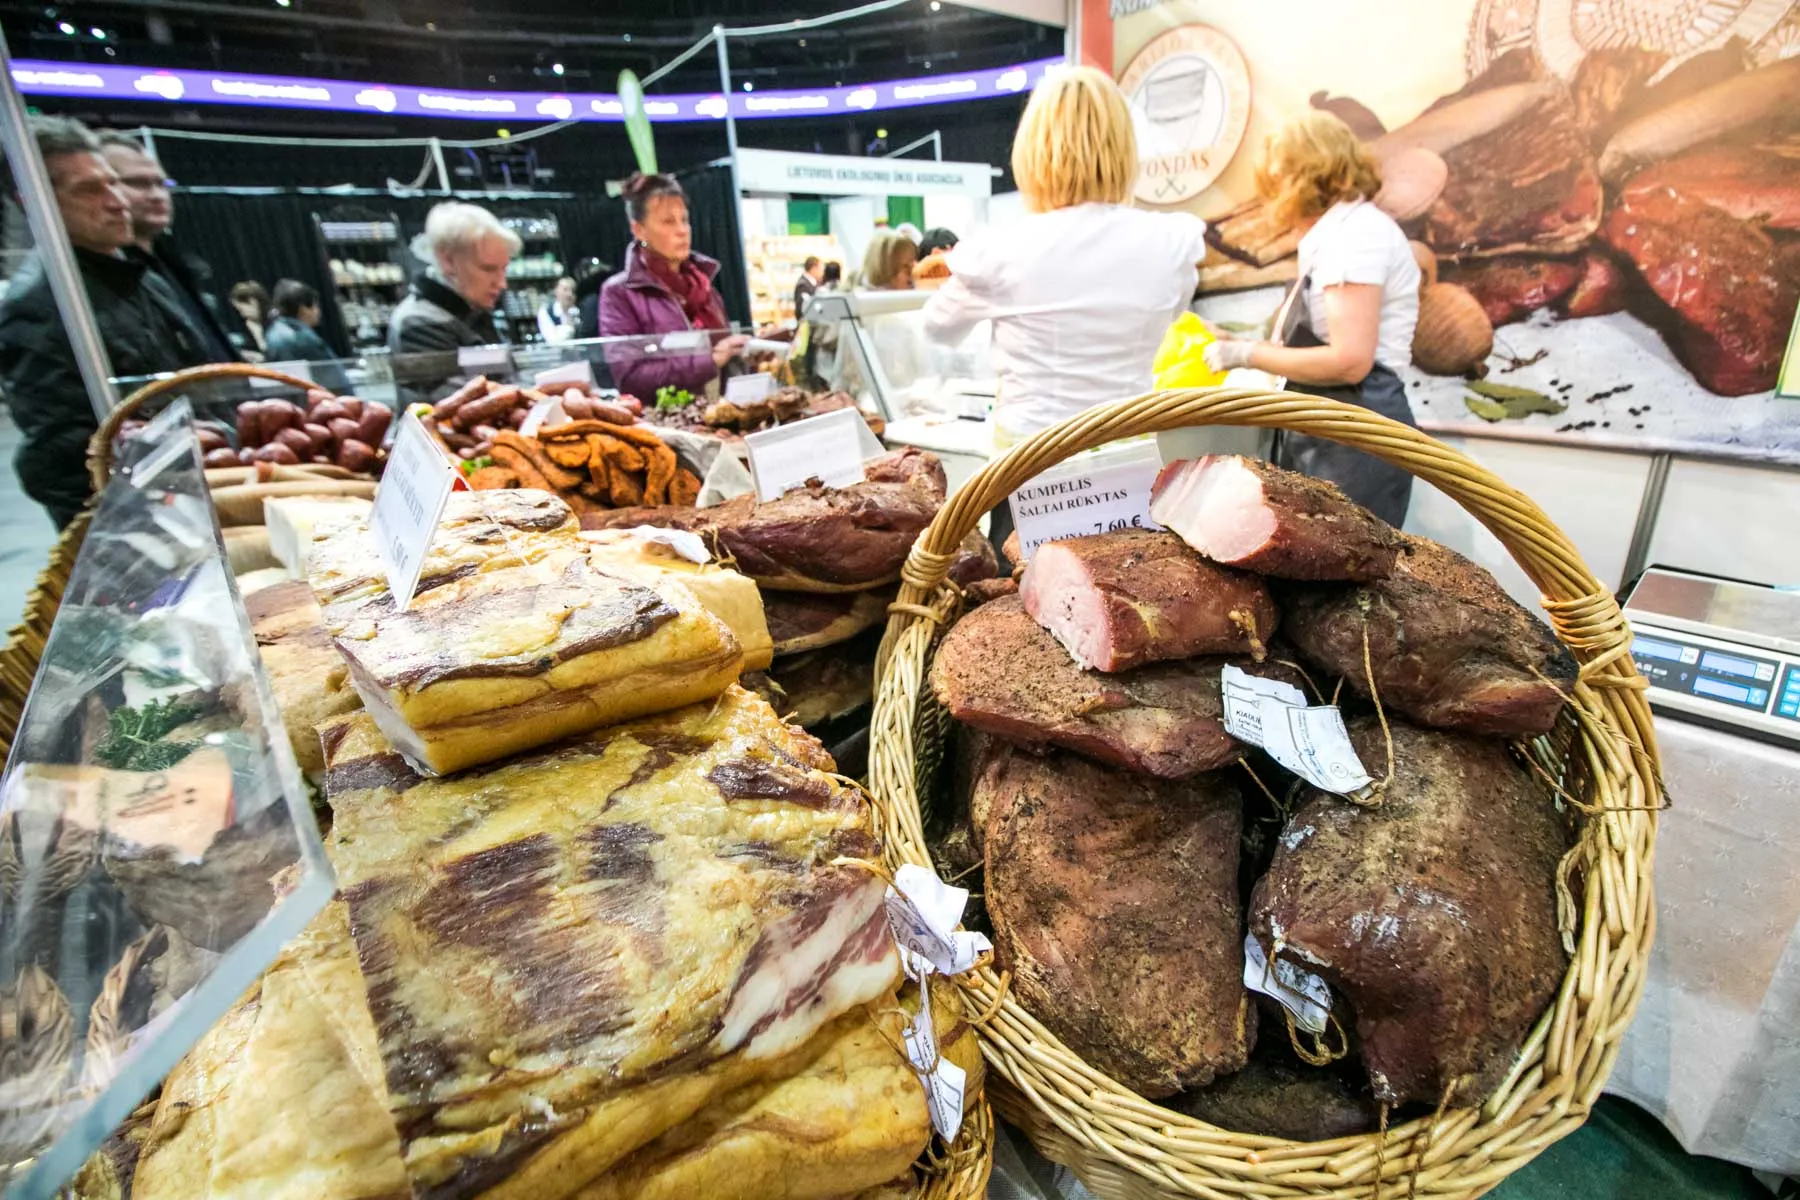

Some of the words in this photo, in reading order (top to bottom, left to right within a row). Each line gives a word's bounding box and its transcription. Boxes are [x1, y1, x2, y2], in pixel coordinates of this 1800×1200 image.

[1016, 478, 1092, 502] KUMPELIS
[1018, 501, 1064, 518] ŠALTAI
[1067, 488, 1128, 509] RŪKYTAS
[1094, 518, 1127, 534] 760
